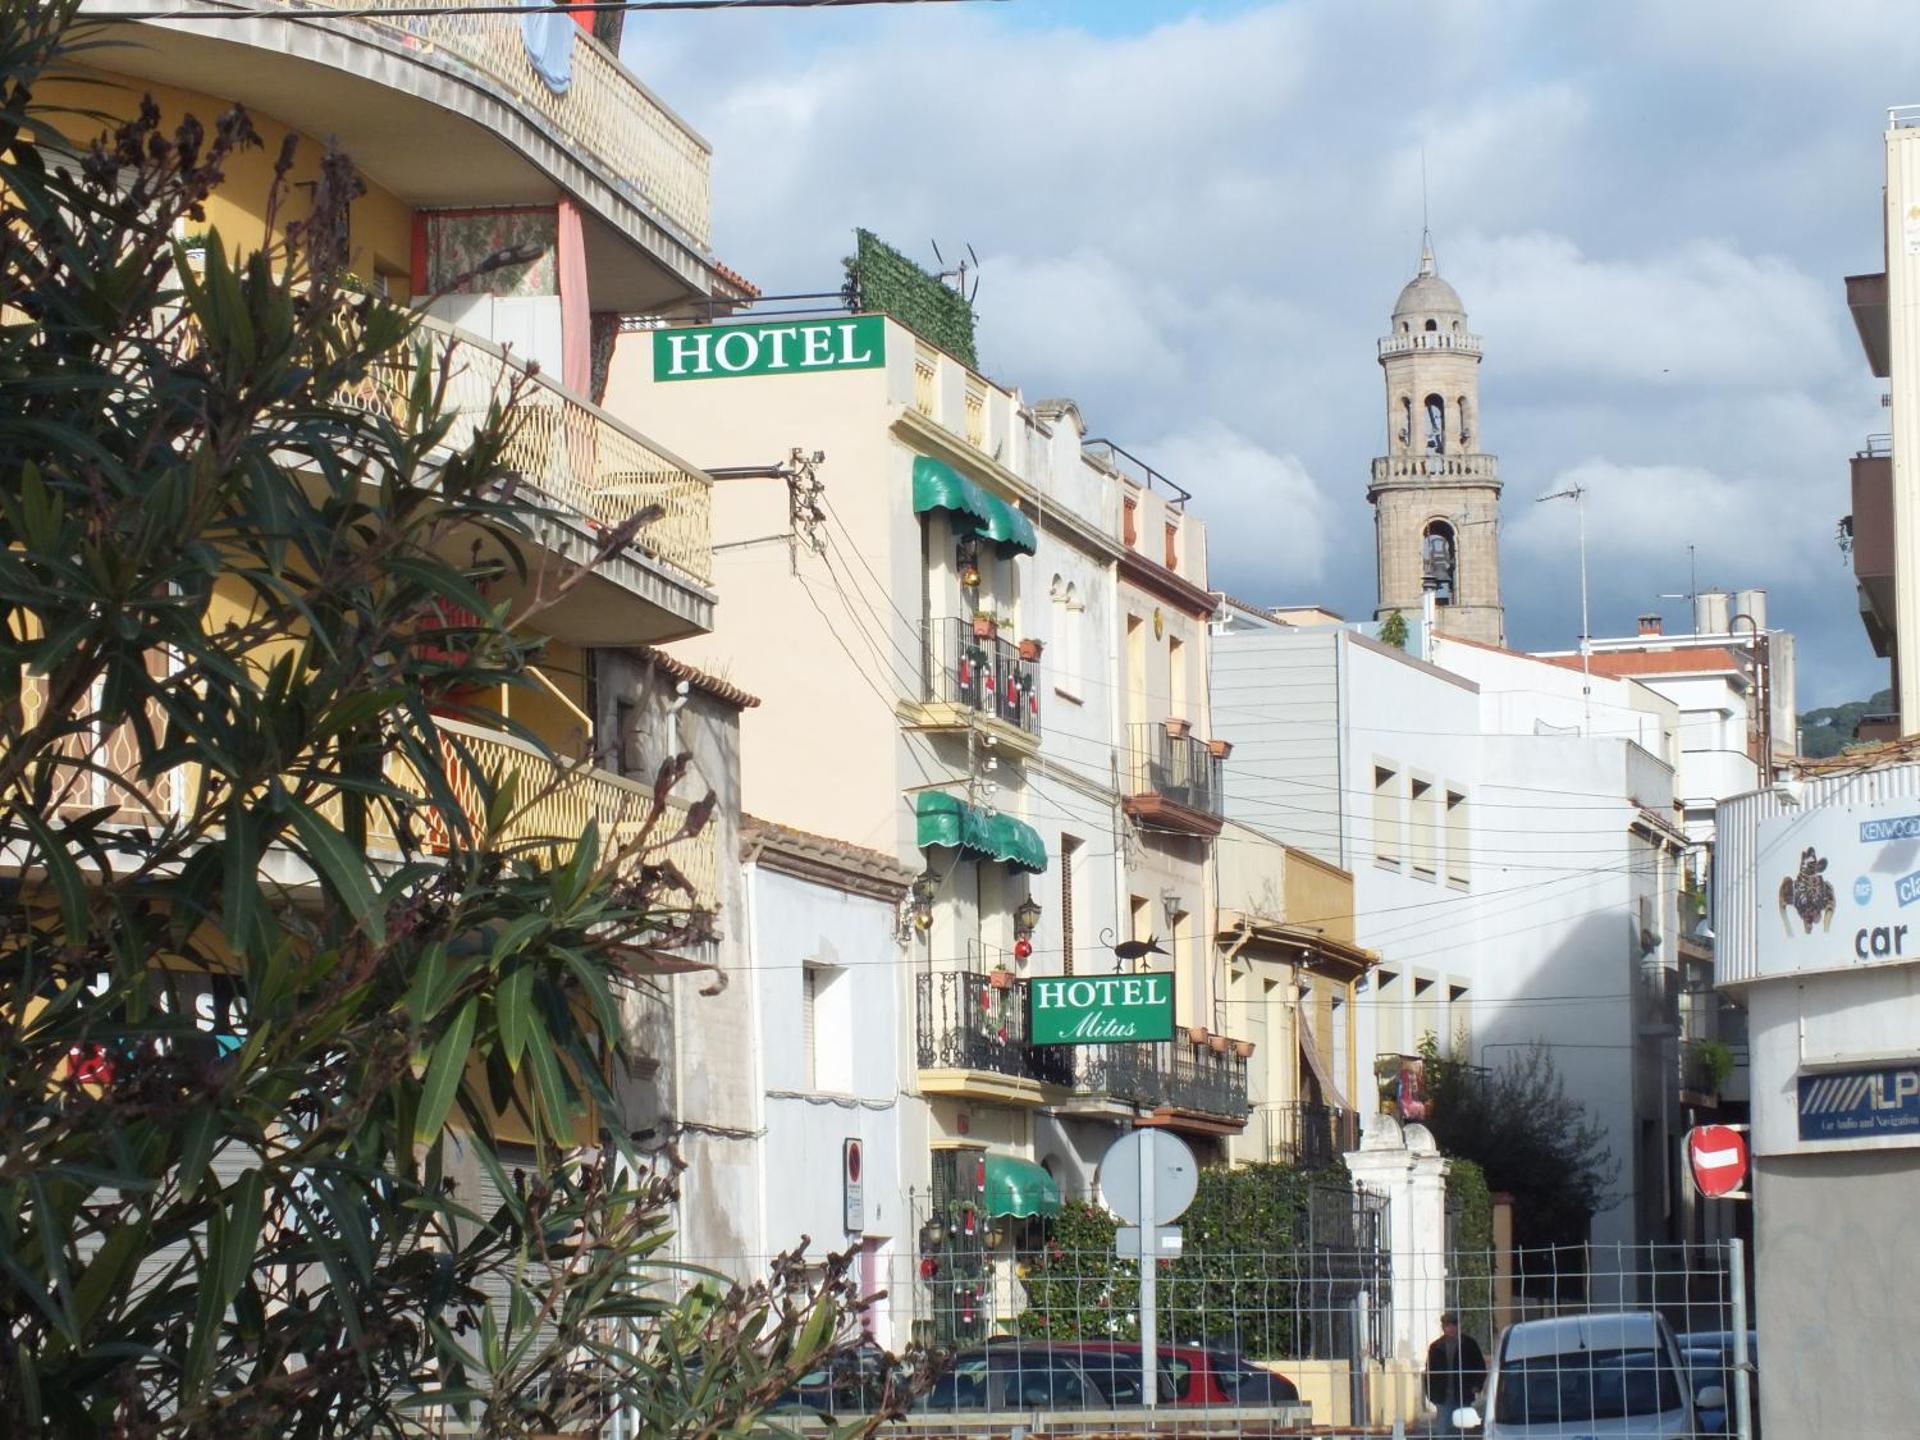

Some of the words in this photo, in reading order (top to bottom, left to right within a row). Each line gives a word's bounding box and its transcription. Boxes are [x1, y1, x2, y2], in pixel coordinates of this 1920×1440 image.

[667, 324, 872, 375] HOTEL
[1861, 818, 1920, 840] KENWOOD
[1855, 924, 1907, 959] car
[1037, 979, 1167, 1008] HOTEL
[1058, 1011, 1138, 1038] Mitus
